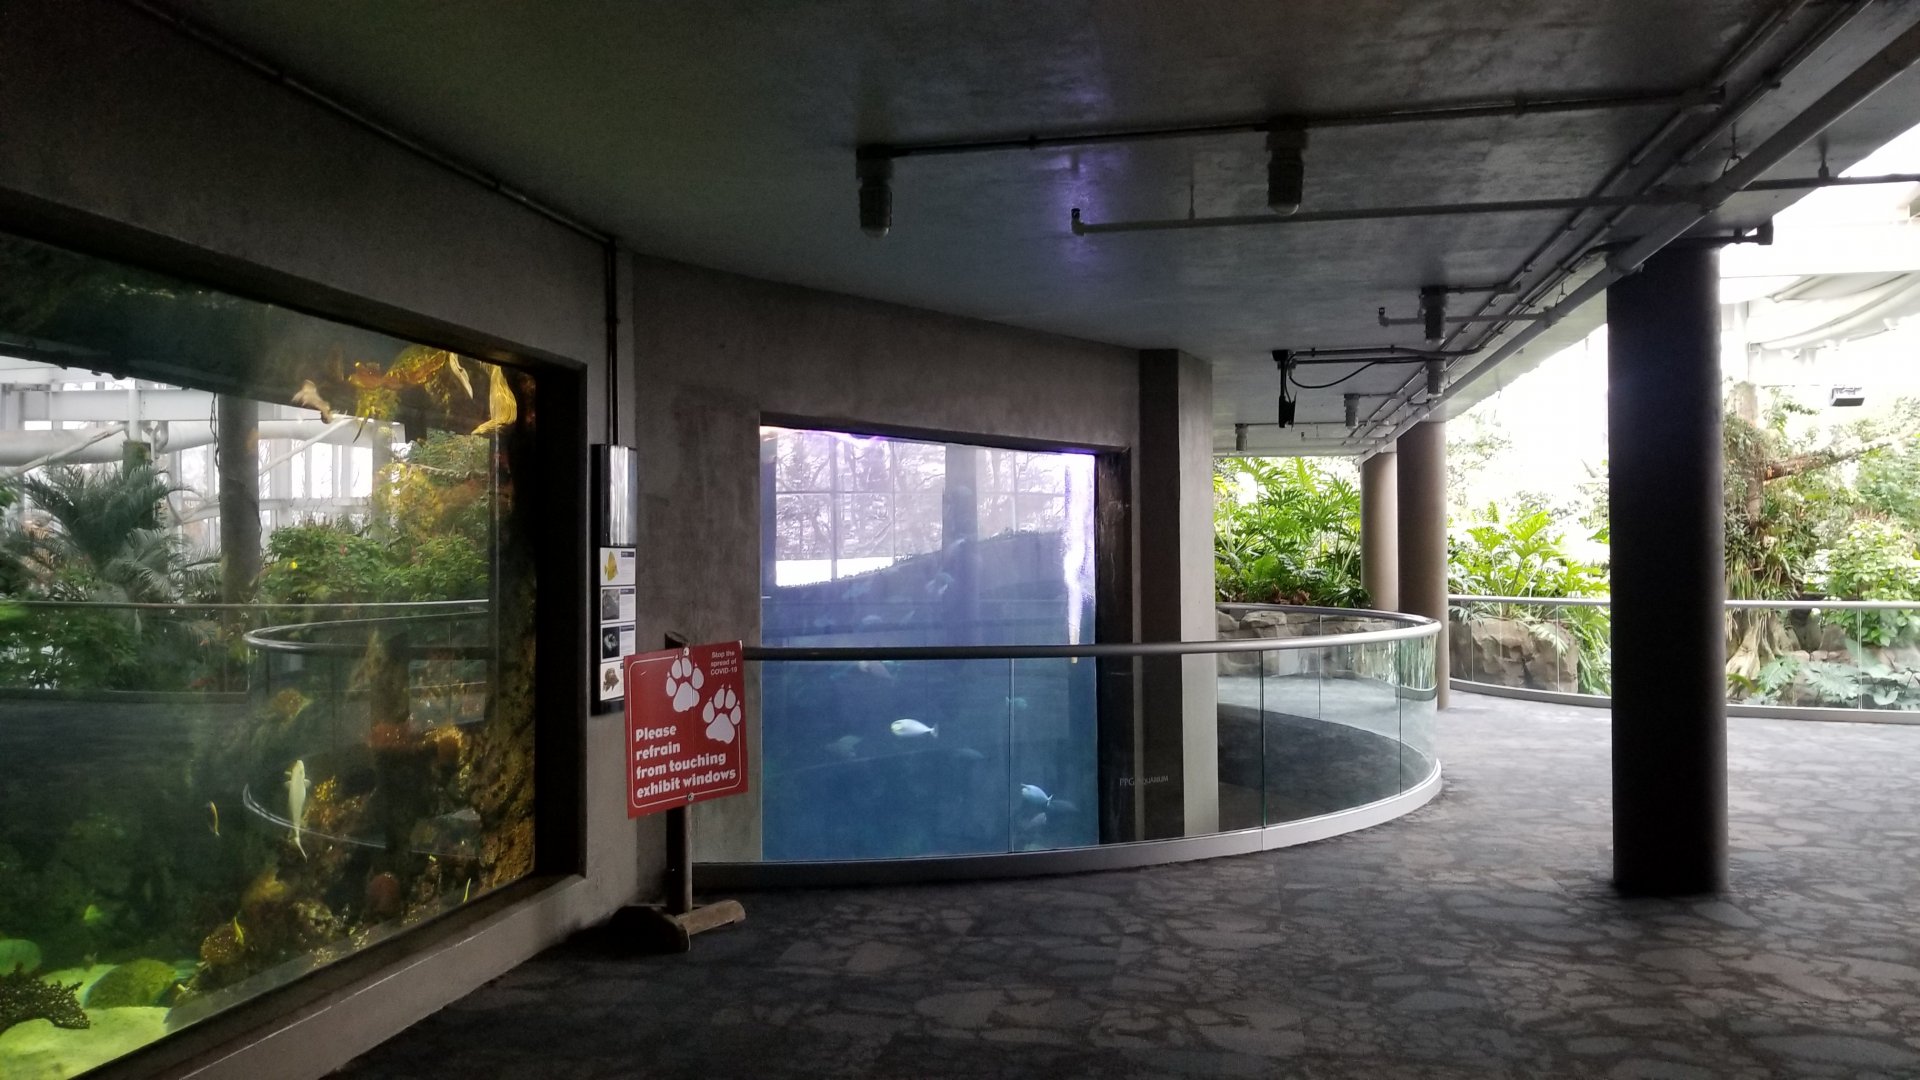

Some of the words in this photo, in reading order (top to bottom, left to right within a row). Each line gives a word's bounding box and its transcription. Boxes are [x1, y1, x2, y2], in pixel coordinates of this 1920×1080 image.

[711, 651, 725, 659] Stop
[710, 659, 730, 668] spread
[730, 657, 737, 665] of
[710, 666, 738, 676] COVID-19
[635, 725, 677, 742] Please
[636, 741, 681, 761] refrain
[636, 762, 667, 780] from
[669, 752, 727, 772] touching
[636, 777, 681, 799] exhibit
[683, 768, 736, 788] windows
[1119, 777, 1135, 787] PPG
